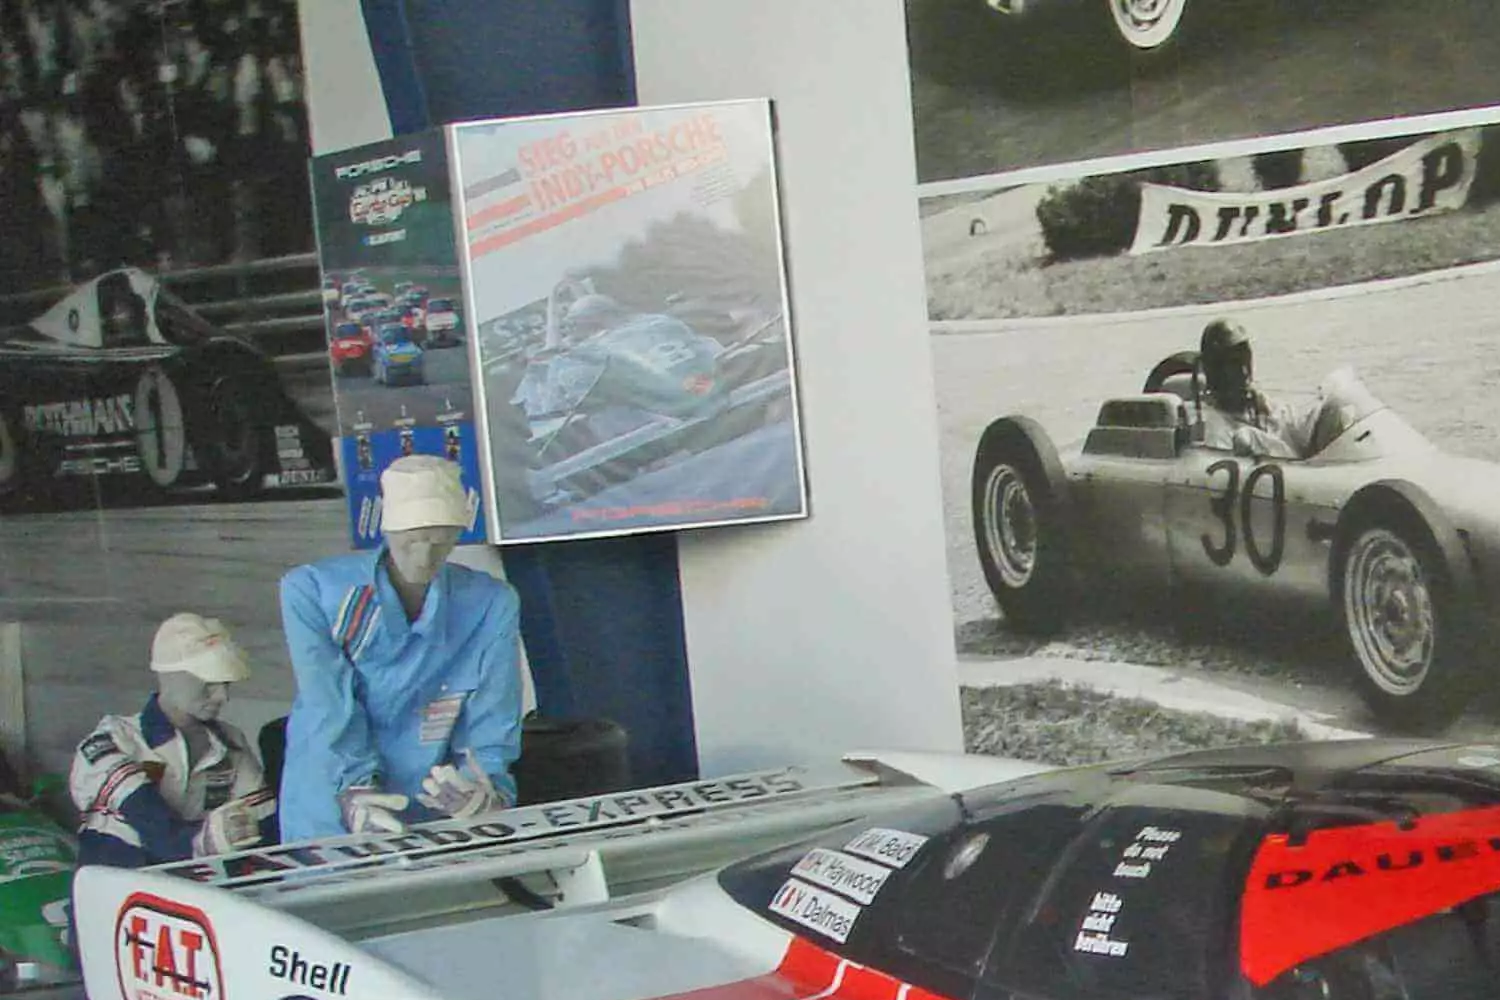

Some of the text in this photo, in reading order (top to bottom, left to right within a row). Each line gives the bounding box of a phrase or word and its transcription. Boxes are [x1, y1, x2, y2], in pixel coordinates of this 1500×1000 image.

[1160, 142, 1464, 247] DUNLOP
[1202, 460, 1285, 576] 30
[824, 858, 883, 895] Haywood
[801, 895, 850, 936] Dalmas
[269, 944, 351, 996] Shell
